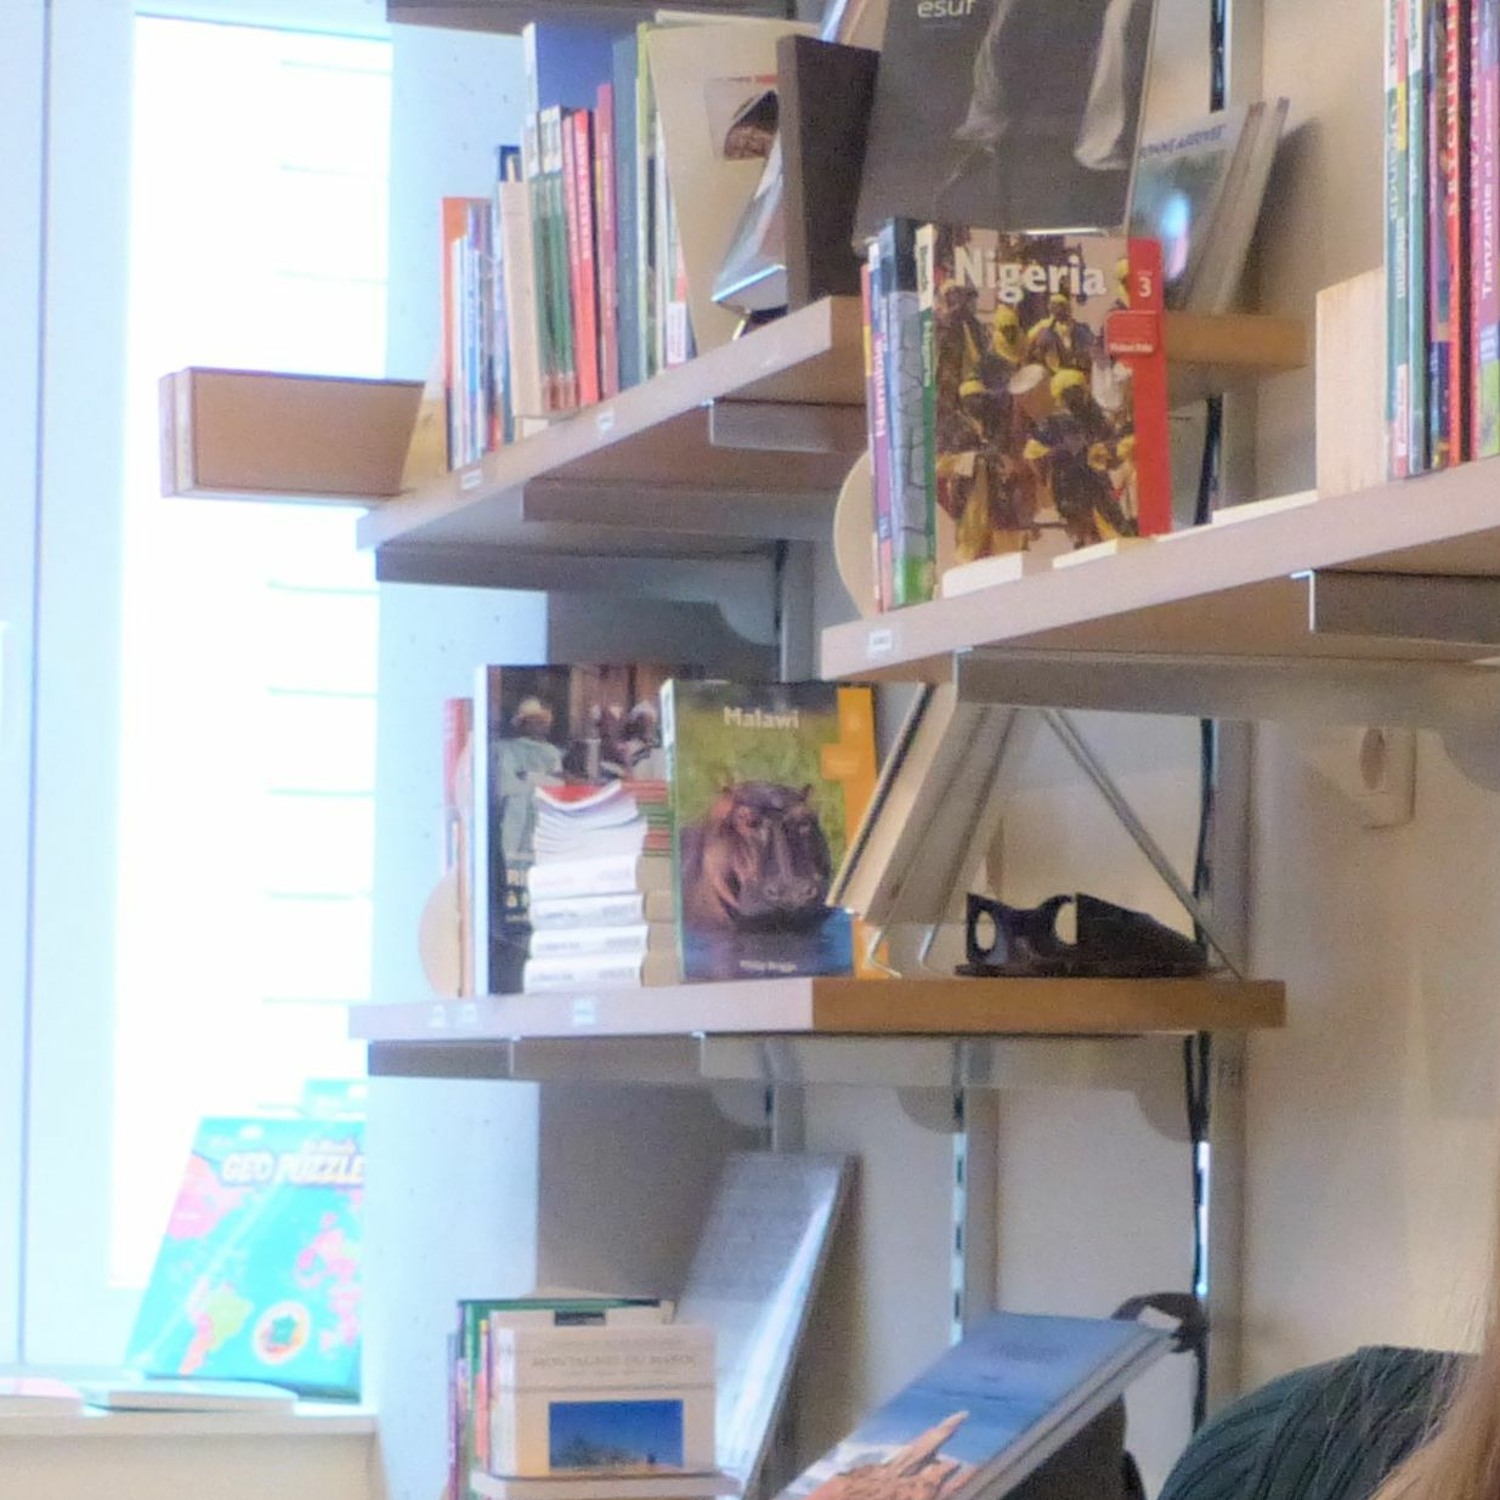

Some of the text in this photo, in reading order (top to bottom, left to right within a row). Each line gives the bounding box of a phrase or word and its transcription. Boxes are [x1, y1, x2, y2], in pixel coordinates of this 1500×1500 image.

[1482, 183, 1493, 299] Tanzanie
[955, 246, 1106, 304] Nigeria
[1138, 275, 1152, 298] 3
[723, 706, 799, 729] Malawi
[223, 1150, 273, 1184] GEO
